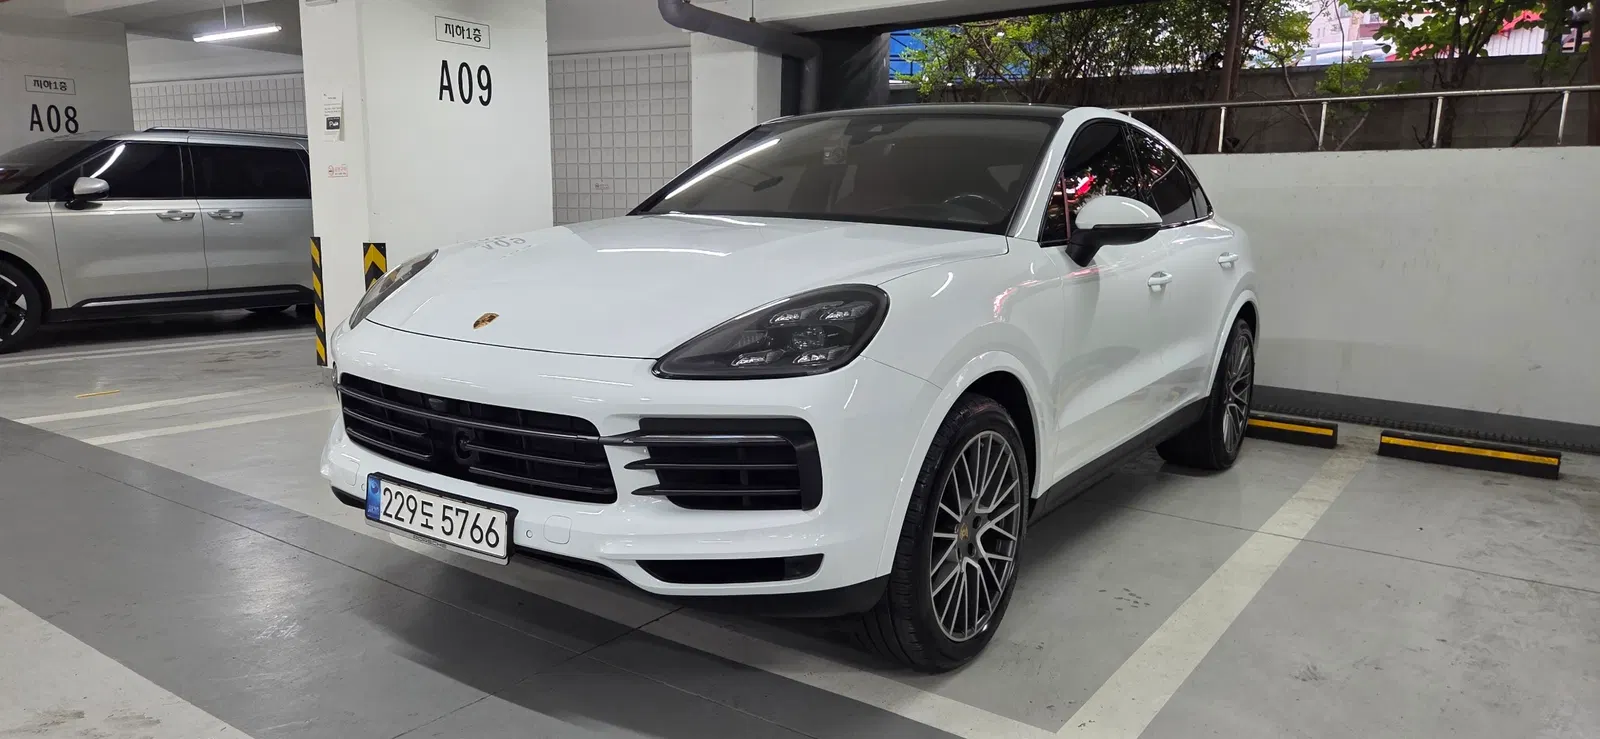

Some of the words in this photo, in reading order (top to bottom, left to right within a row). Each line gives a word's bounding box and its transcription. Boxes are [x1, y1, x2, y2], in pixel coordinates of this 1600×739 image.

[444, 23, 482, 43] 지하1층
[439, 60, 492, 106] A09
[30, 104, 79, 134] A08
[383, 487, 434, 530] 229도
[441, 504, 500, 548] 5766
